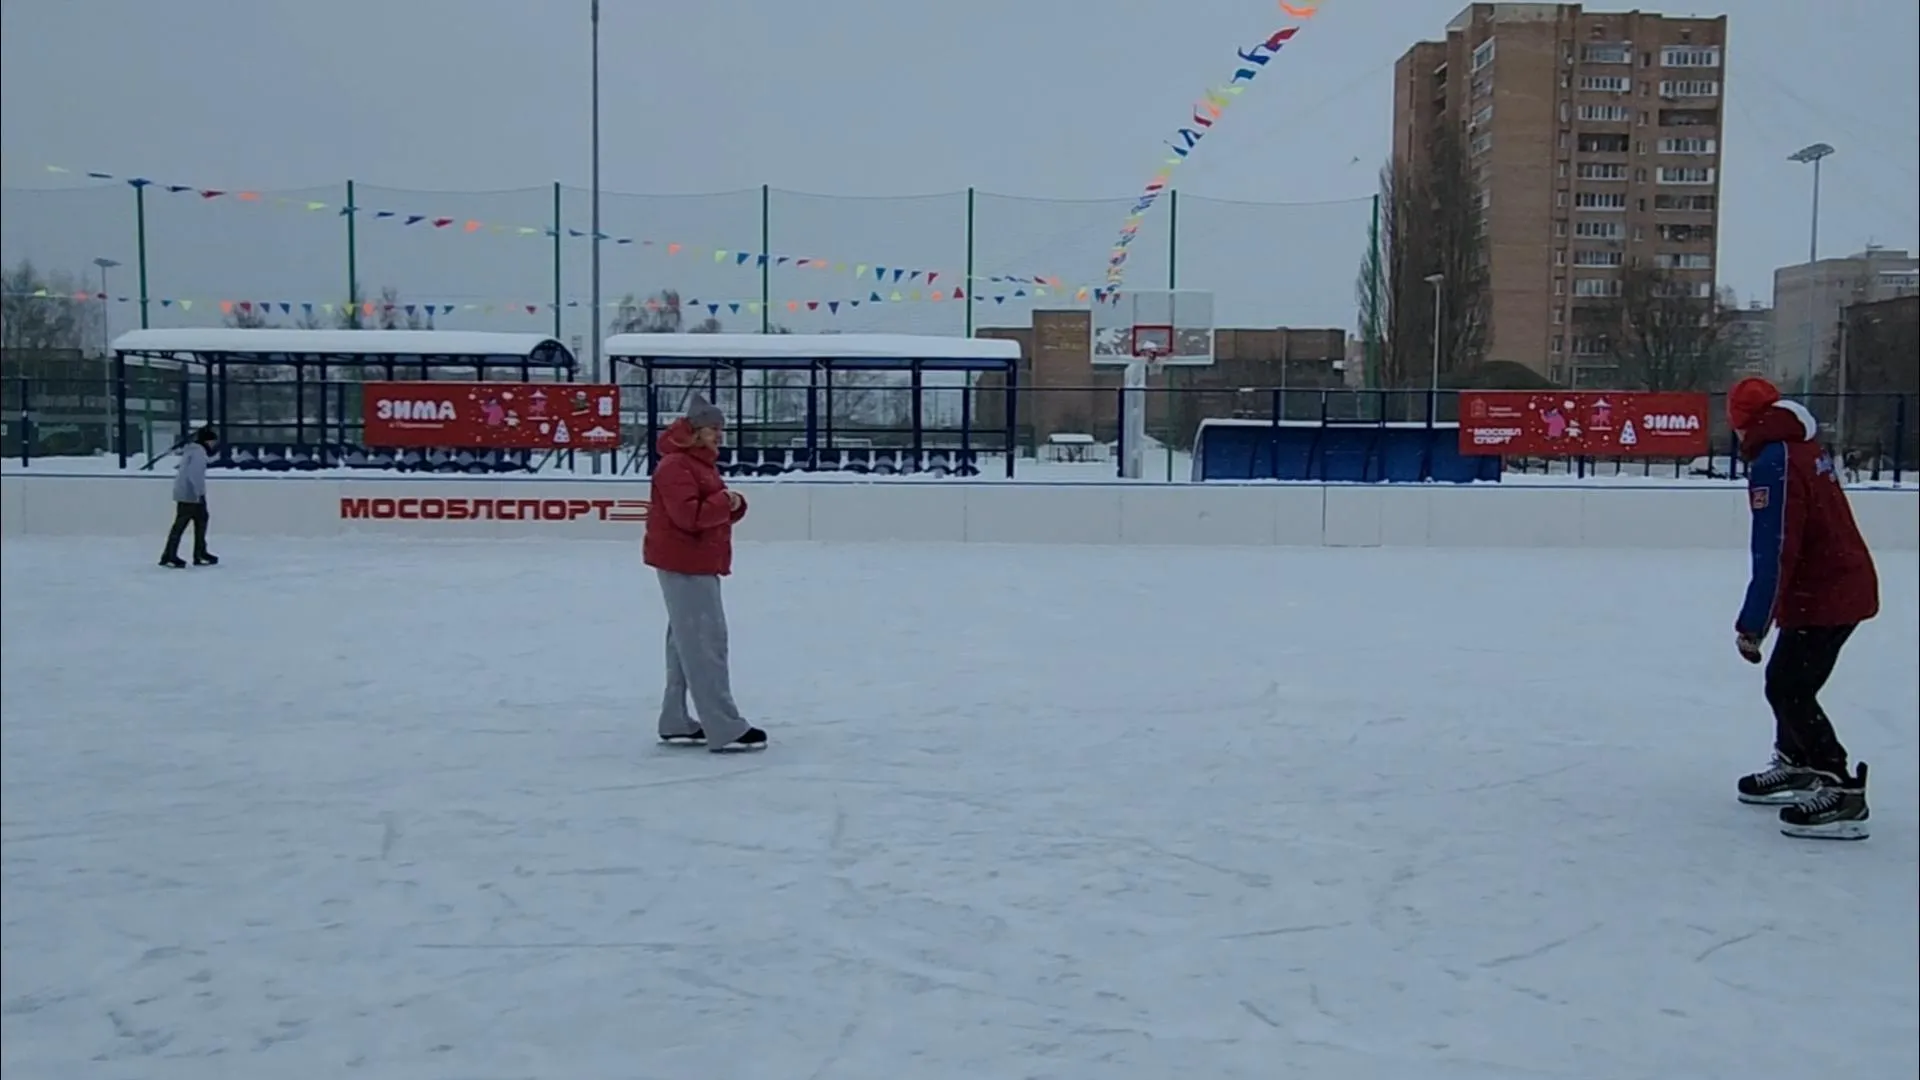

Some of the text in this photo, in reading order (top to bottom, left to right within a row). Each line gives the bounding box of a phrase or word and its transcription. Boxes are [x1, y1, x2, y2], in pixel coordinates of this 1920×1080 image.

[376, 399, 457, 420] ЗИМА
[1643, 414, 1700, 430] ЗИМА
[340, 498, 616, 521] МОСОБЛСПОРТ
